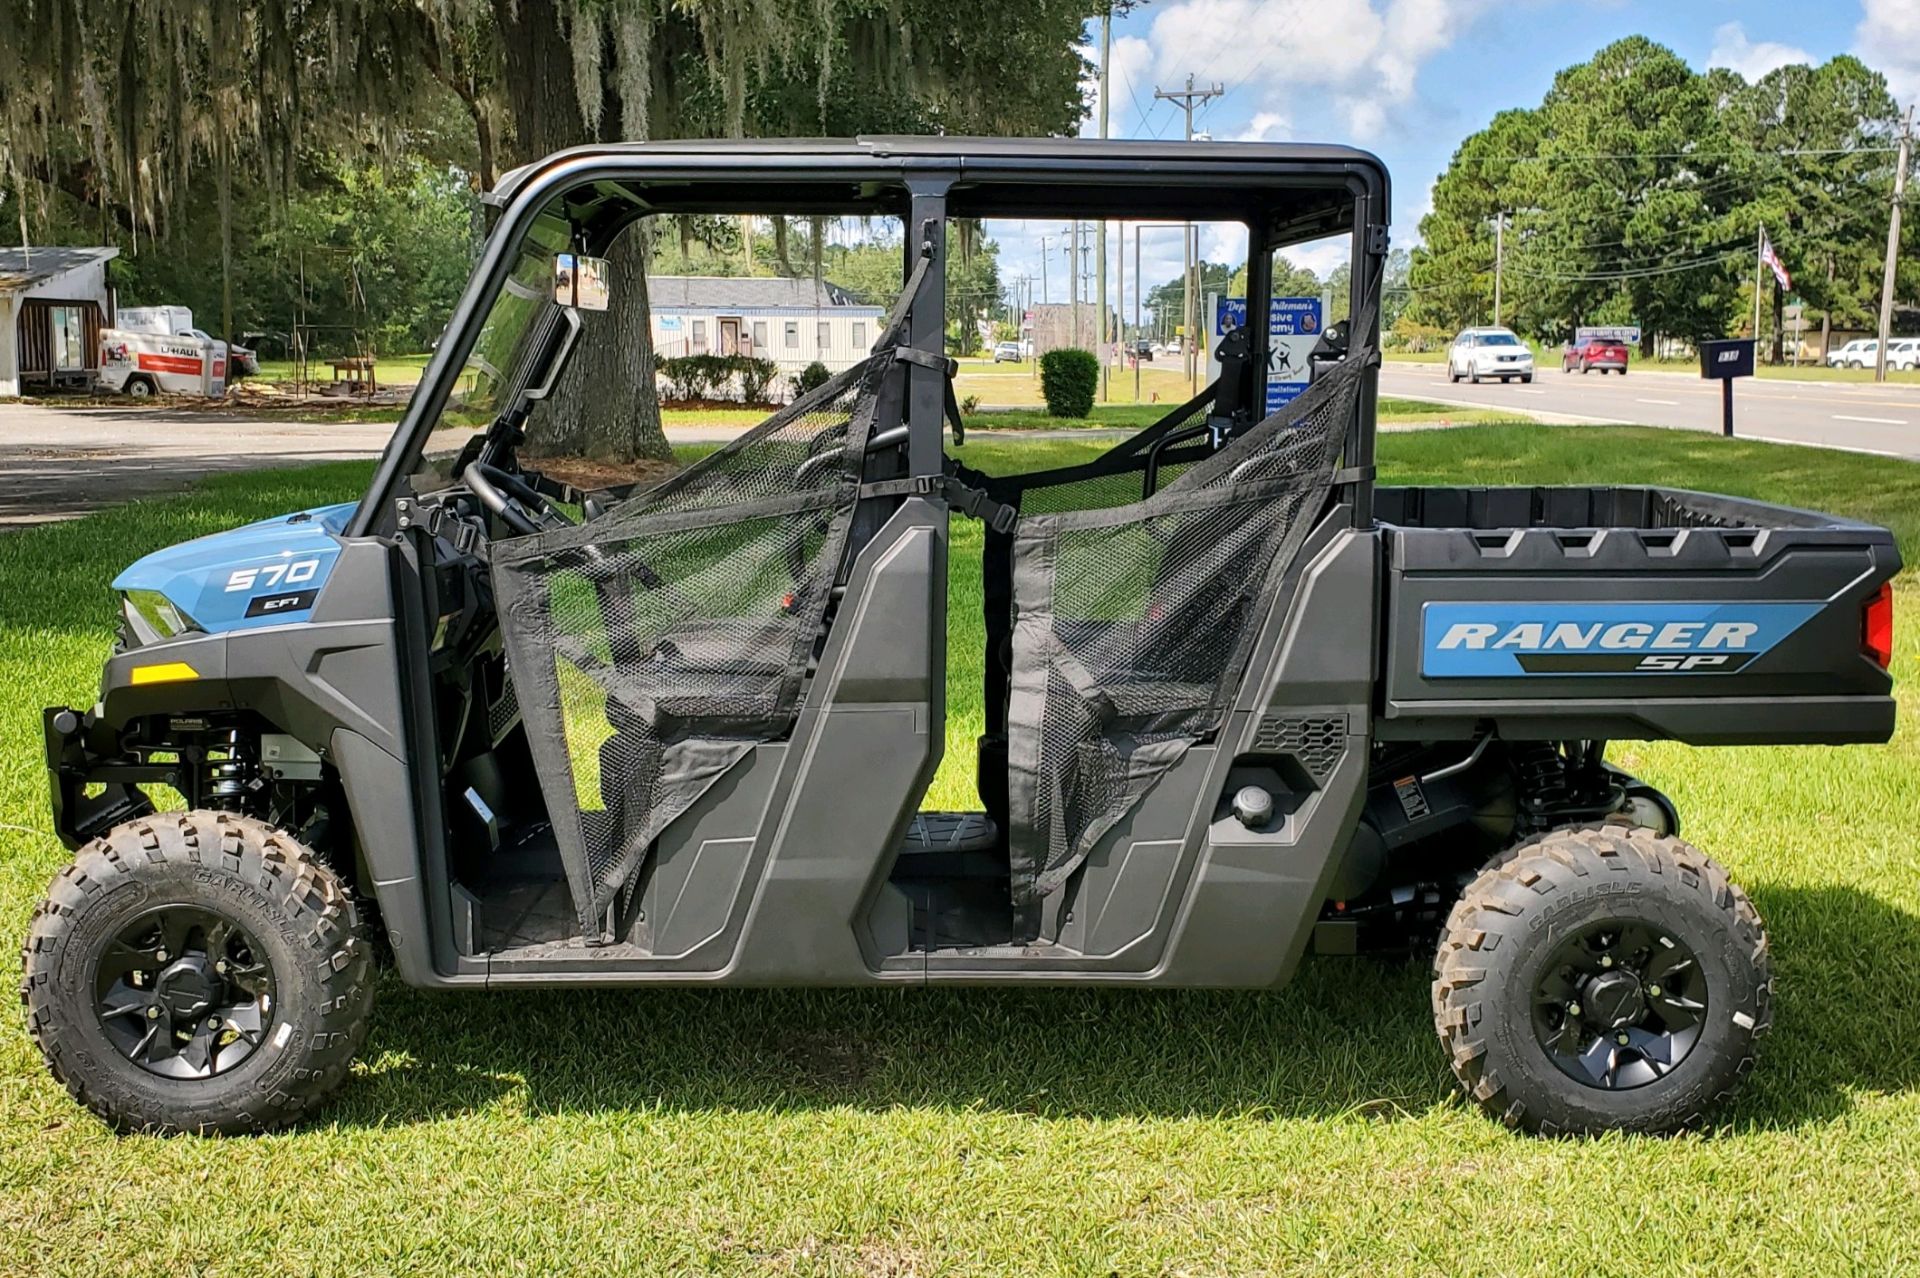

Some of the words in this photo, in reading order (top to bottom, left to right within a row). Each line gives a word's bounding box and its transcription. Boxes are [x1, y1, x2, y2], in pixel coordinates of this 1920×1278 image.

[225, 559, 320, 593] 570
[263, 596, 300, 611] EFI
[1436, 622, 1759, 650] RANGER
[1634, 654, 1730, 671] SP
[193, 868, 301, 946] CARLISLE
[1528, 881, 1643, 932] CARLISLE
